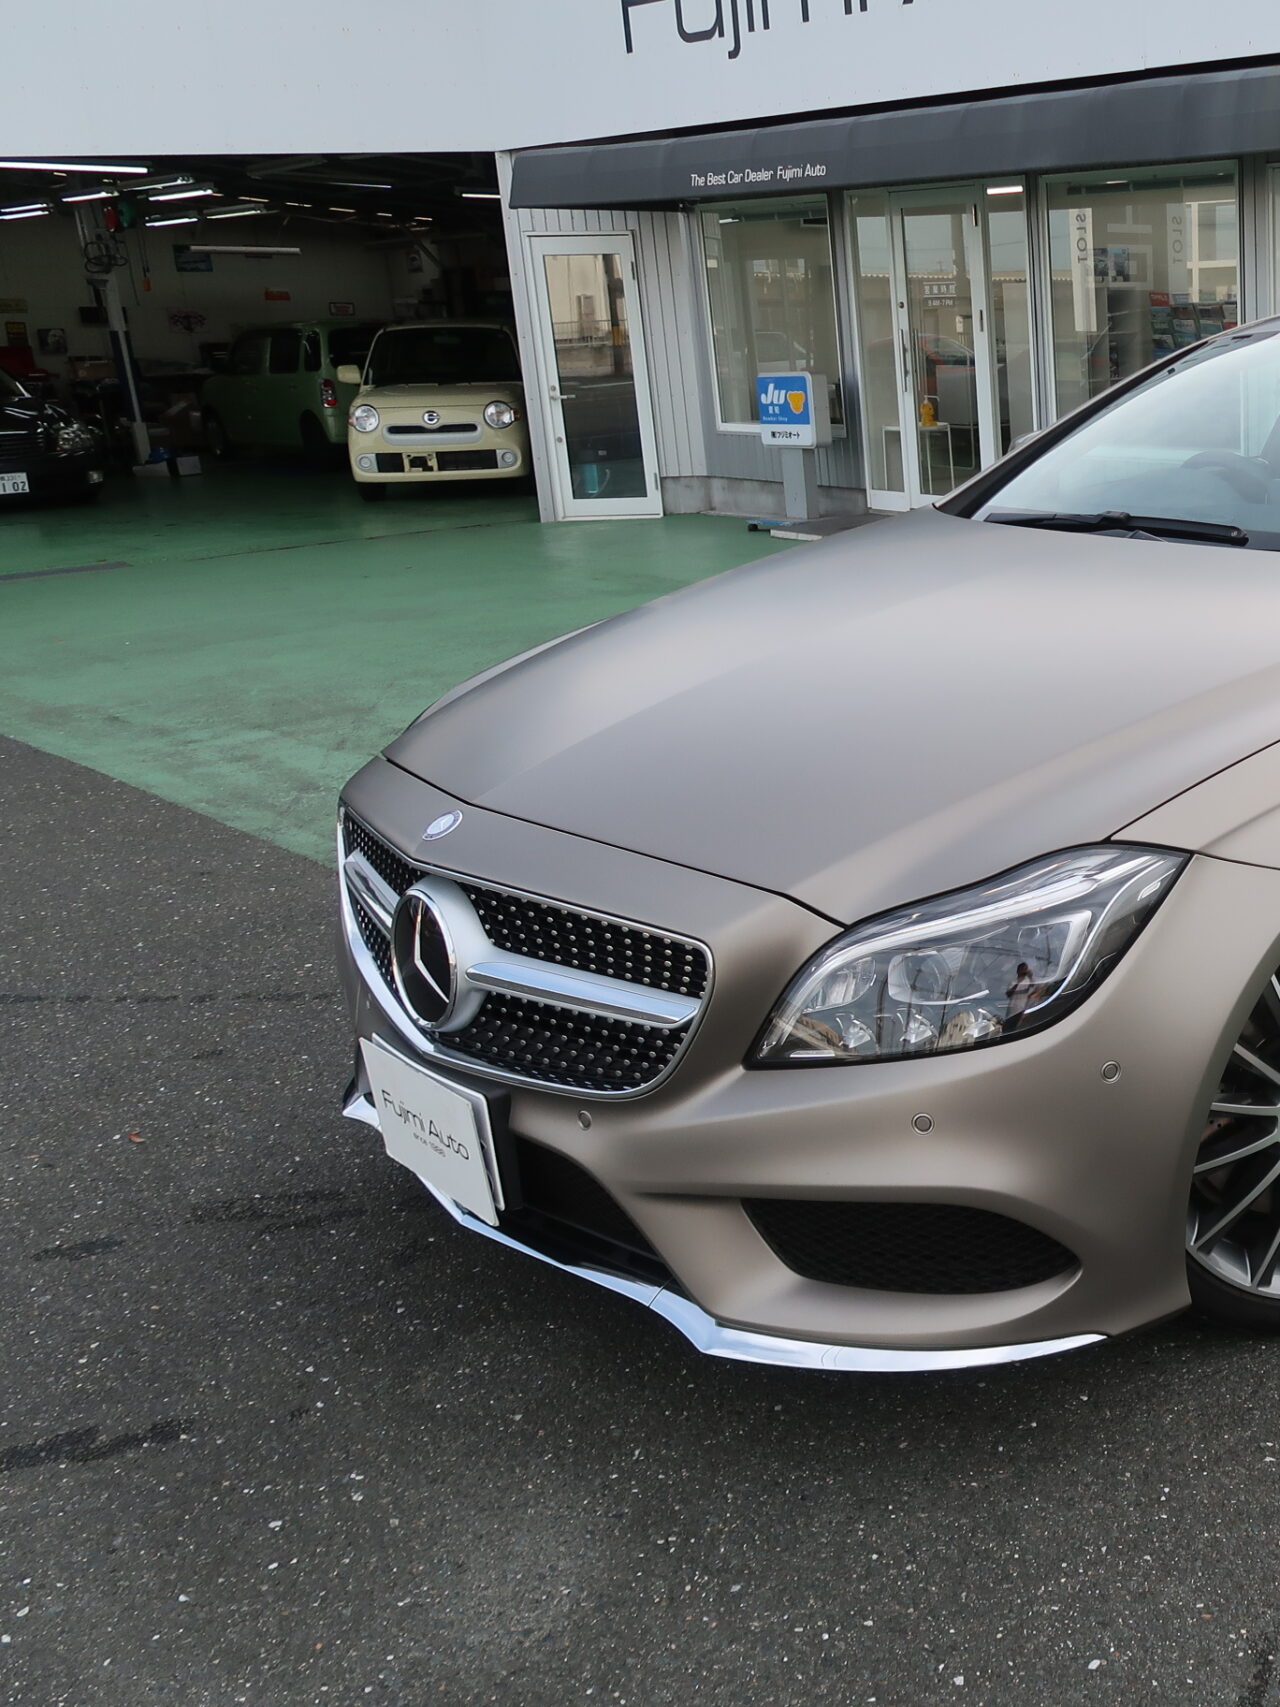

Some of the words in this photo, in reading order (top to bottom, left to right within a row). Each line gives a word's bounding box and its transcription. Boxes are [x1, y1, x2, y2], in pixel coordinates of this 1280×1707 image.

[691, 174, 705, 187] The
[707, 172, 726, 186] Best
[728, 170, 743, 184] Car
[745, 168, 774, 183] Dealer
[777, 165, 803, 182] Fujimi
[805, 163, 827, 177] Auto
[381, 1089, 426, 1134] Fujimi
[428, 1119, 470, 1160] Auto
